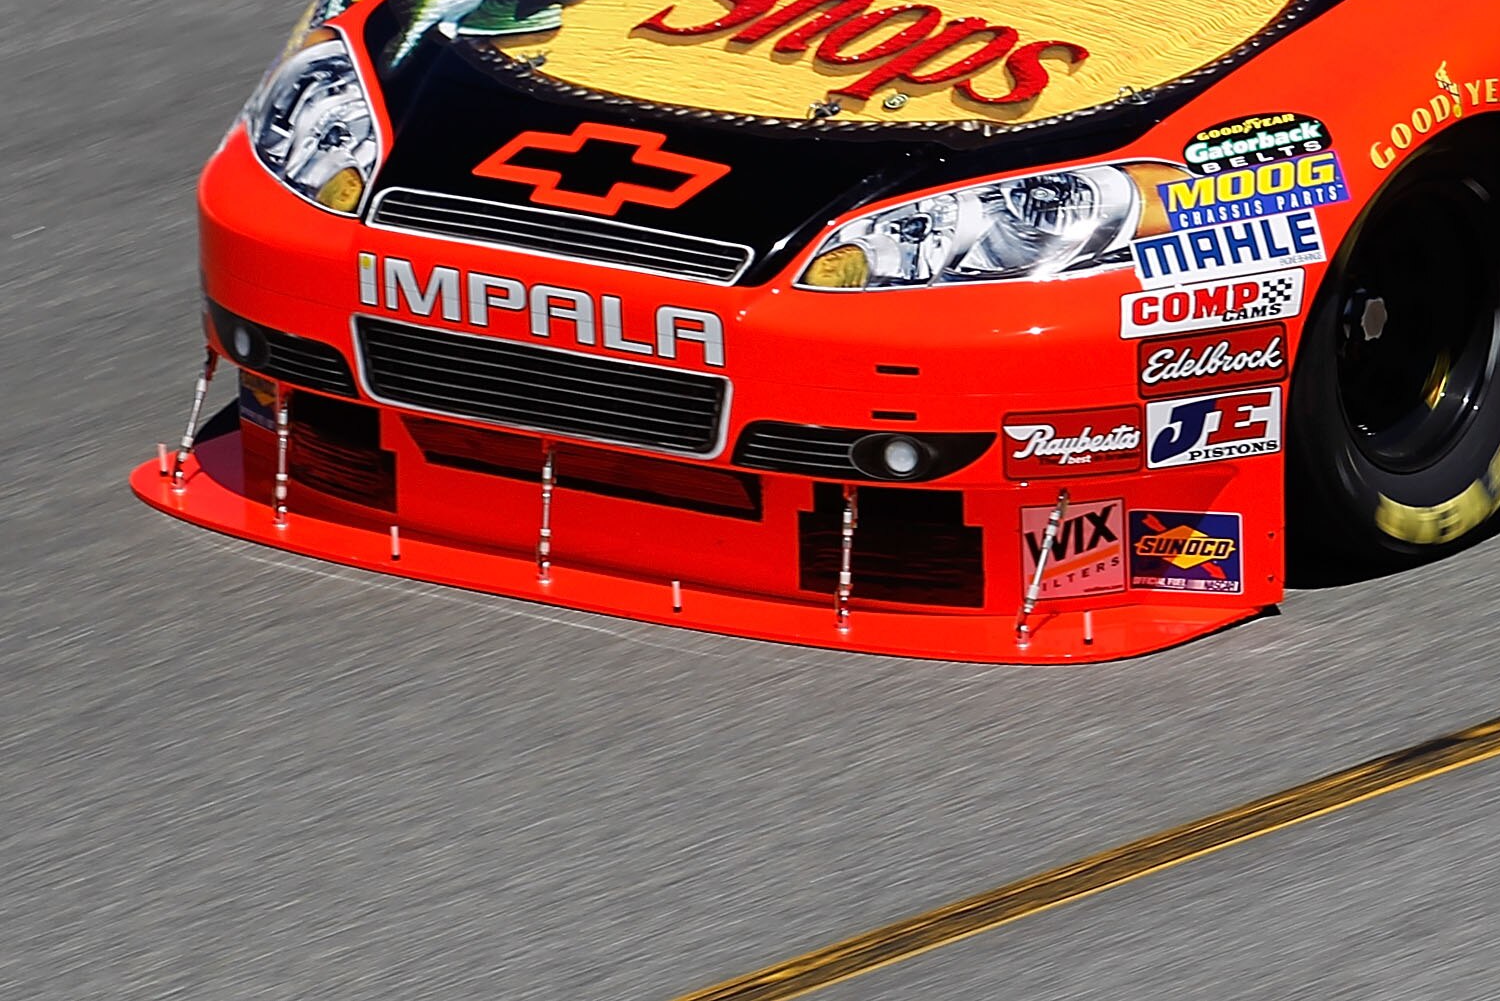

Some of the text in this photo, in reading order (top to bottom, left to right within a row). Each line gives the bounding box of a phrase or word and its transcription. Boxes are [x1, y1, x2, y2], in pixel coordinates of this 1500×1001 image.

[1185, 121, 1322, 164] Gatorback
[1202, 141, 1322, 174] BELTS
[1168, 153, 1336, 212] MOOG
[1179, 185, 1338, 228] CHASSIS PARTS
[1135, 210, 1320, 279] MAHLE
[358, 251, 726, 367] IMPALA
[1132, 282, 1260, 326] COMP
[1222, 303, 1282, 322] CAMS
[1141, 337, 1283, 384] Edelbrock
[1003, 423, 1141, 464] Raybestos
[1151, 391, 1273, 464] JE
[1190, 440, 1278, 461] PISTONS
[1025, 503, 1118, 569] WIX
[1141, 537, 1232, 558] SUNOCO
[1037, 556, 1120, 592] ILTERS
